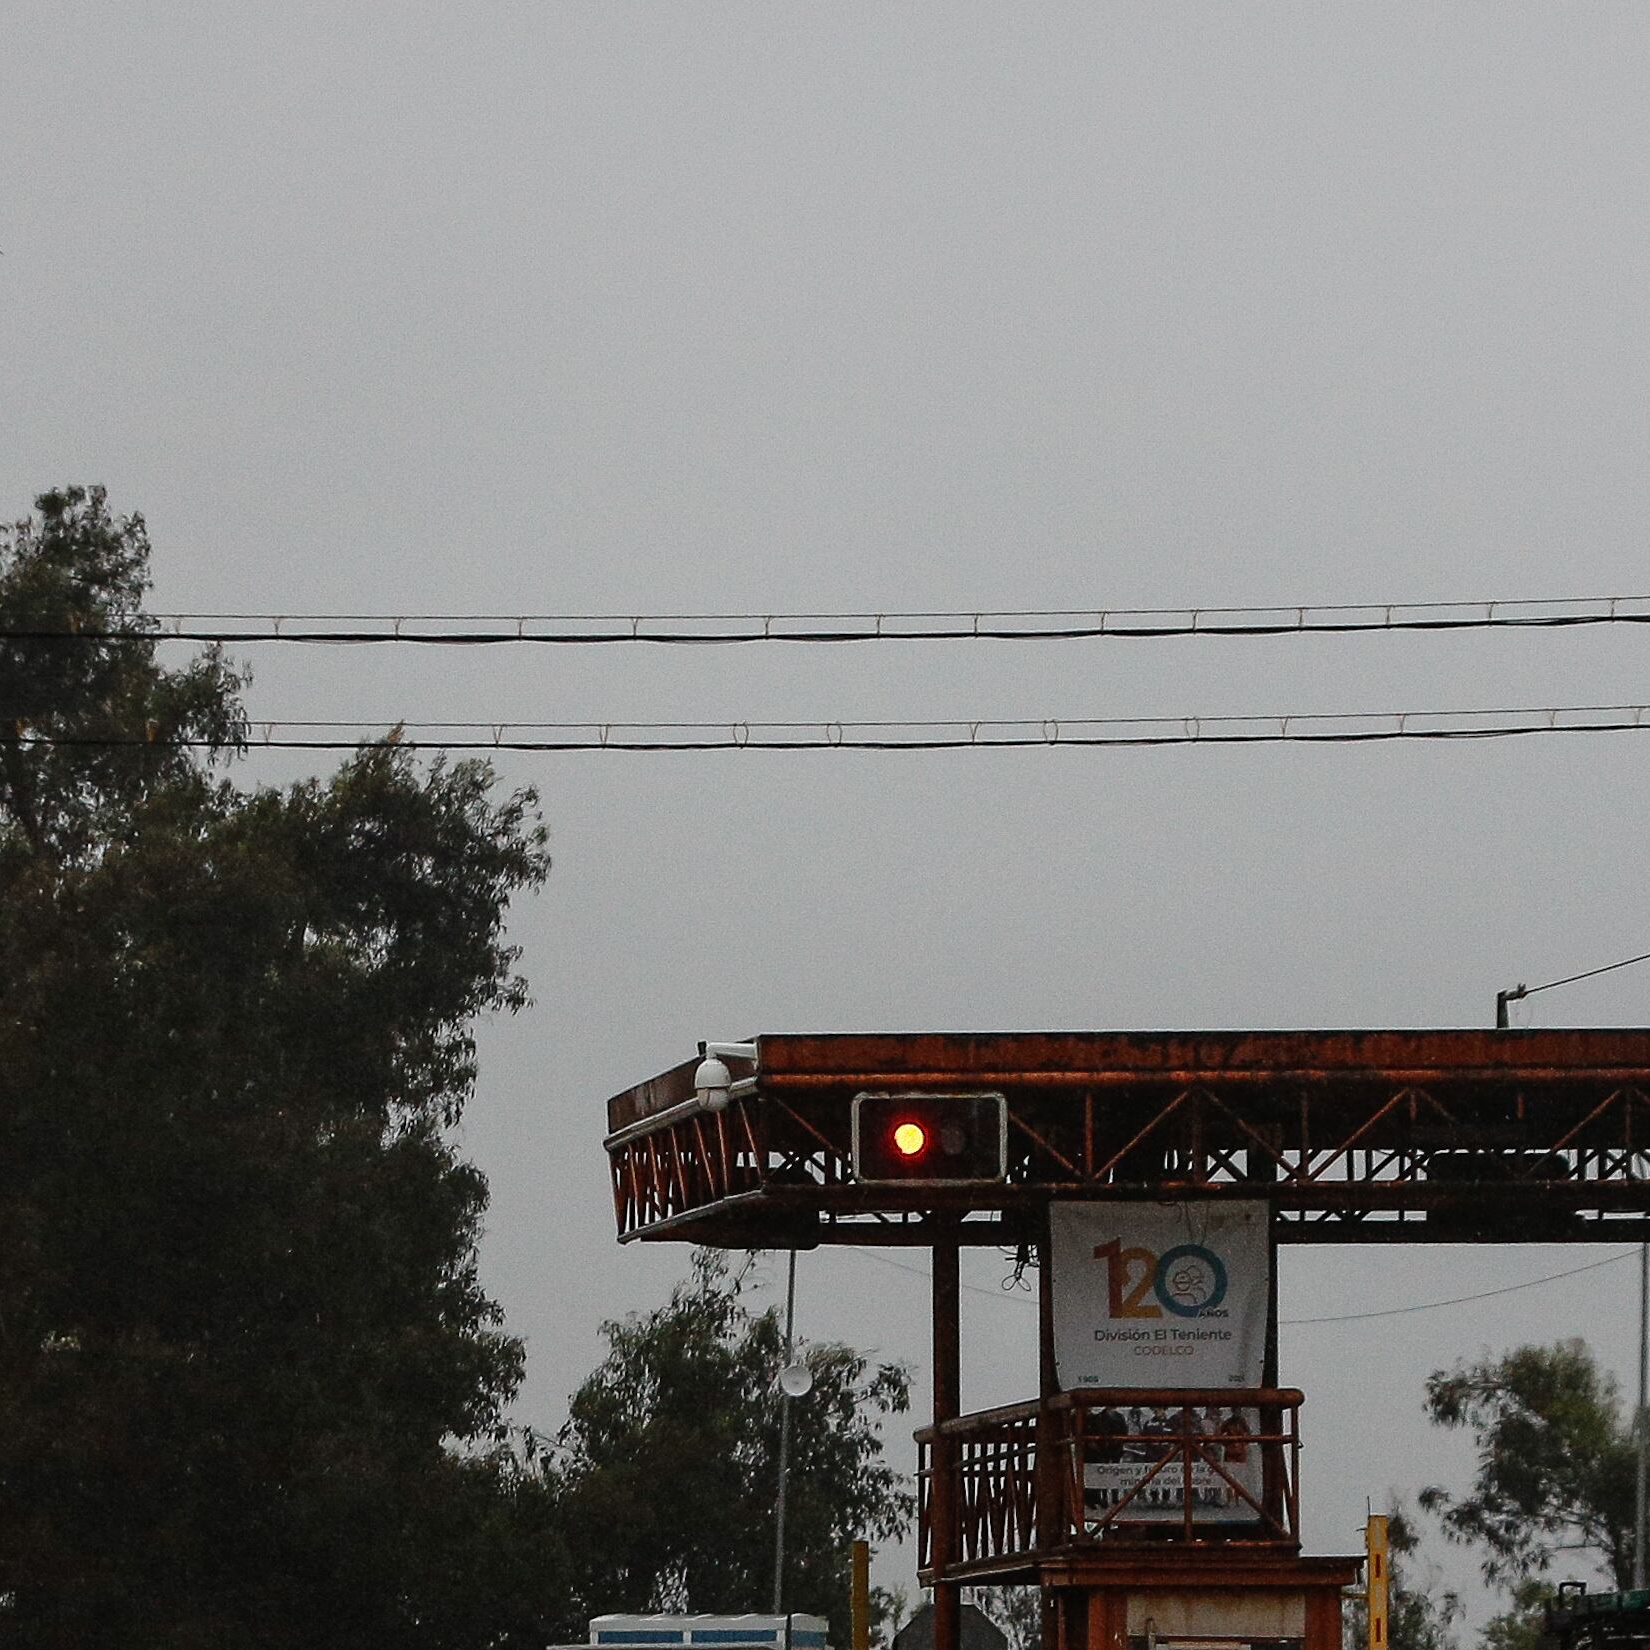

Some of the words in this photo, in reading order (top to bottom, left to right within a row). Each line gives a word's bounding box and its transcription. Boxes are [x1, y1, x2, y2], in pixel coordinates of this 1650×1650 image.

[1093, 1236, 1228, 1318] 120
[1094, 1328, 1150, 1341] División
[1155, 1330, 1166, 1340] El
[1171, 1329, 1232, 1341] Teniente
[1133, 1345, 1194, 1356] CODELCO
